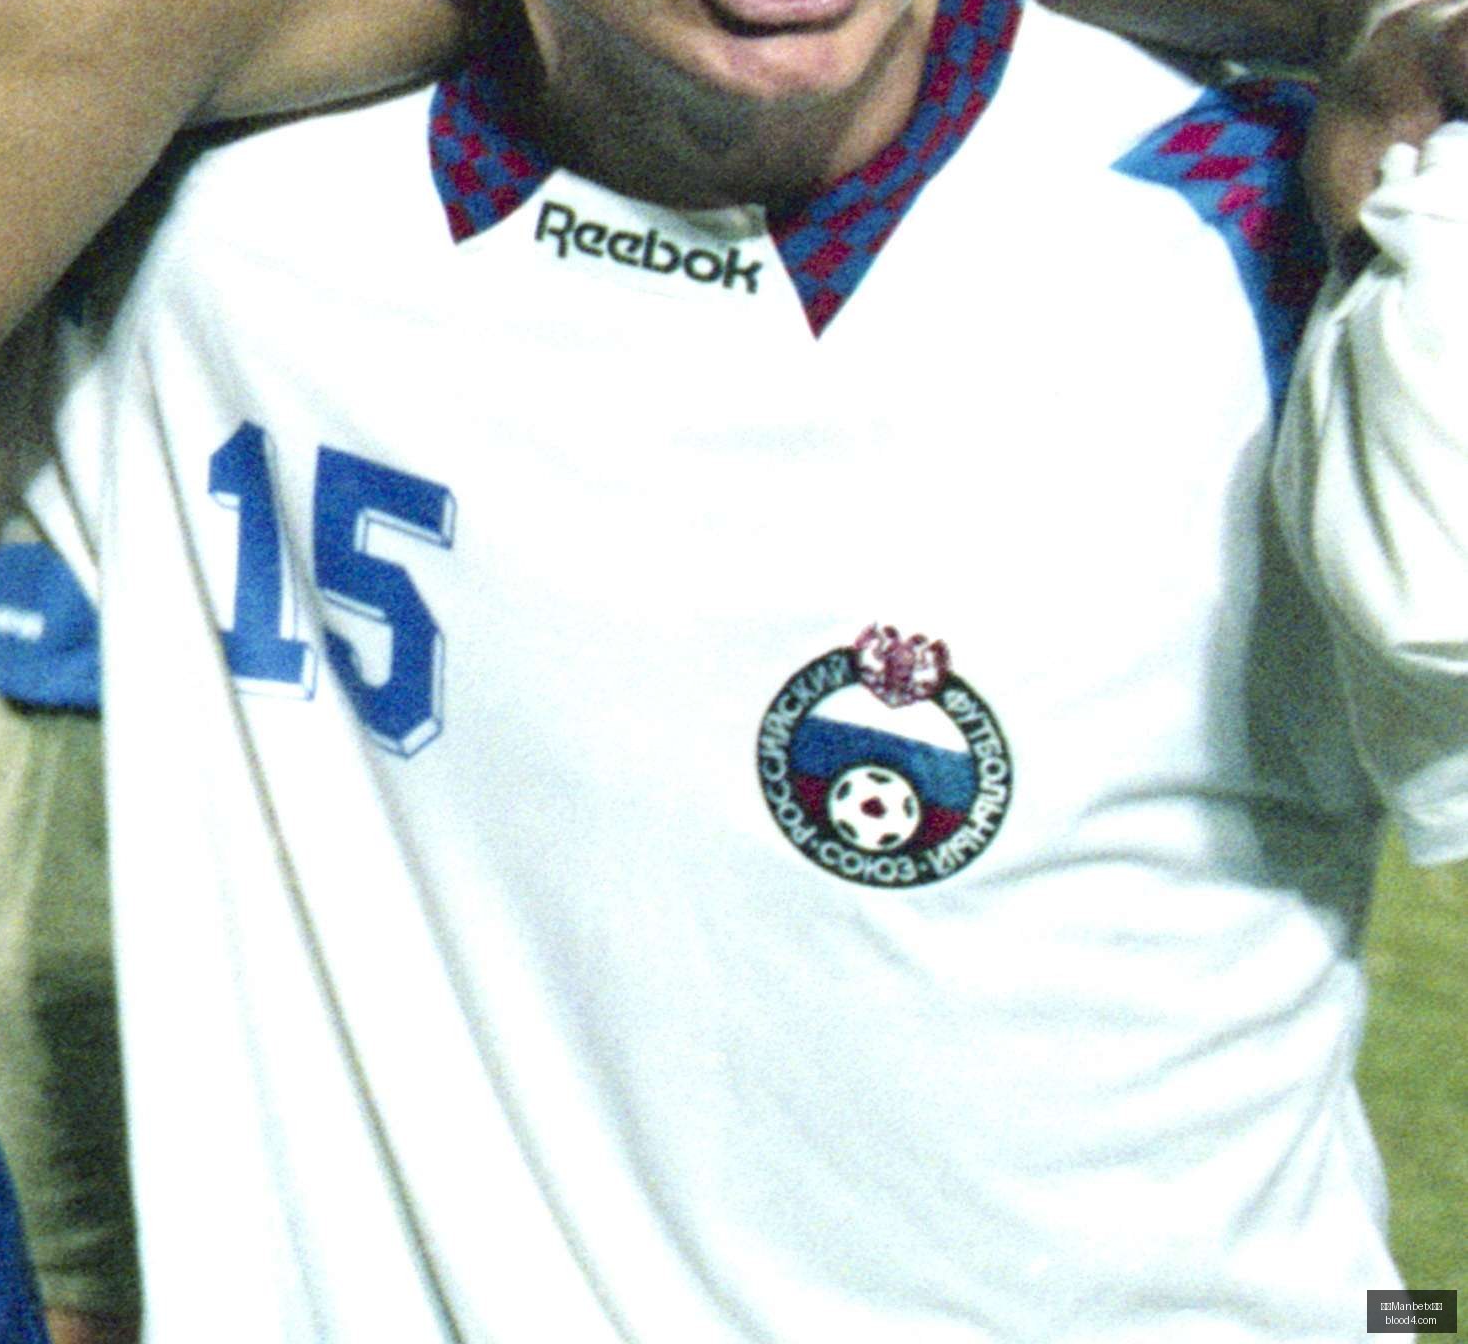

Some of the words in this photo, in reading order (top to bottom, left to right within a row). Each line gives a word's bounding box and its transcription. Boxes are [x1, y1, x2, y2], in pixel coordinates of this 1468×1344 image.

[535, 200, 763, 294] Reebok
[208, 419, 457, 760] 15
[819, 840, 917, 882] СОЮЗ
